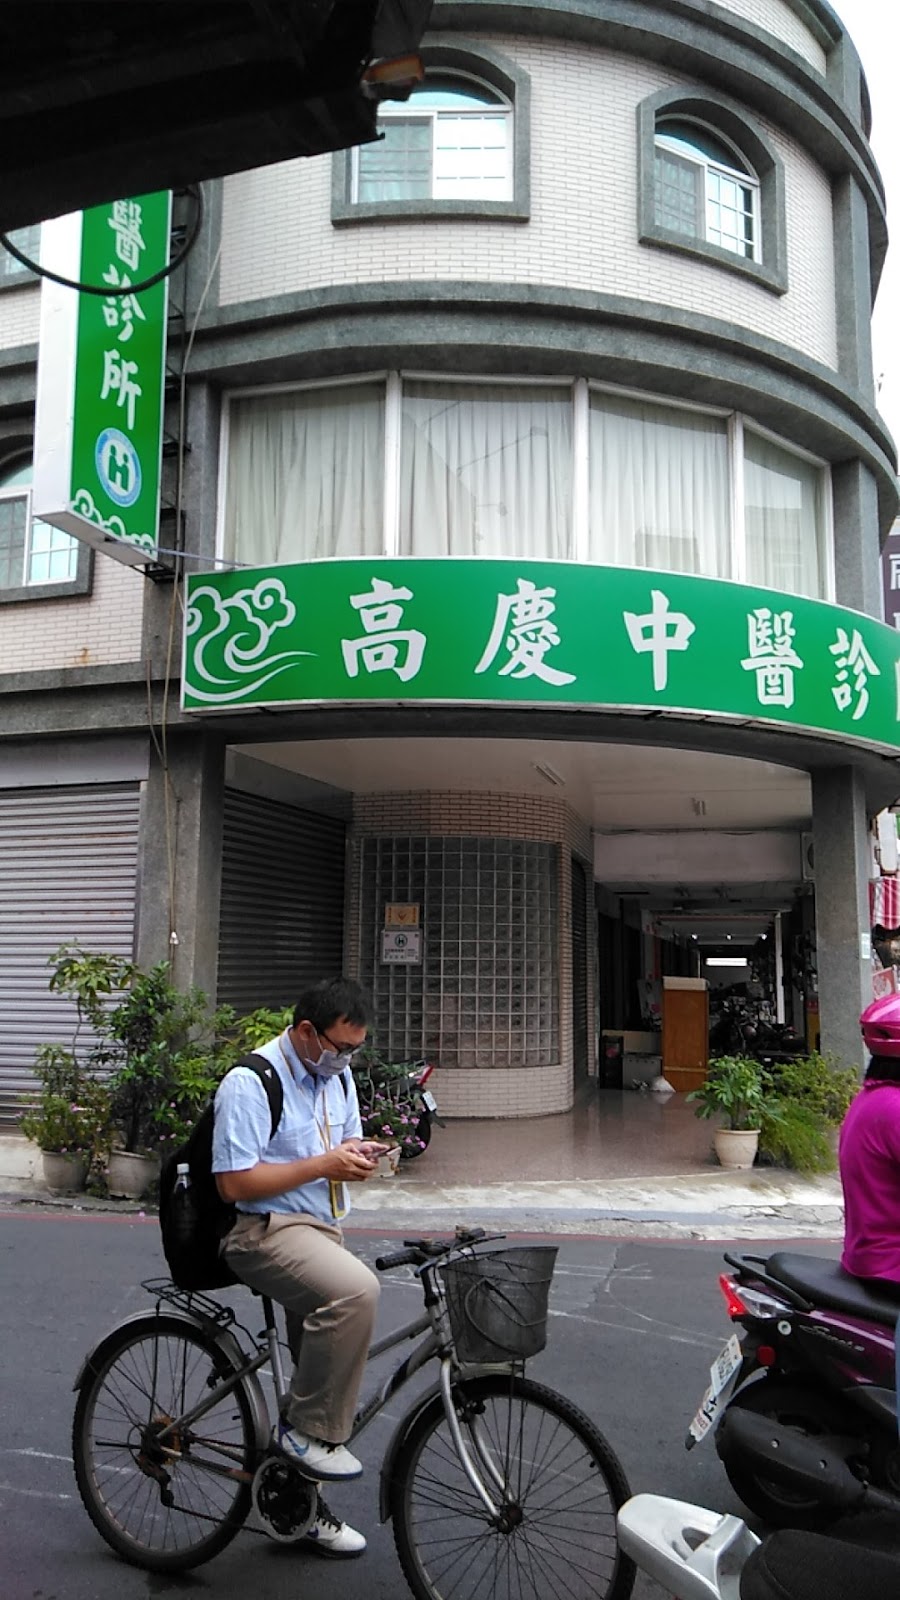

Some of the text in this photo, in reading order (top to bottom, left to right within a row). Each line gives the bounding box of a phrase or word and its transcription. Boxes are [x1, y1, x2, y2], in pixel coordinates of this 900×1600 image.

[341, 577, 900, 723] 高慶中醫診
